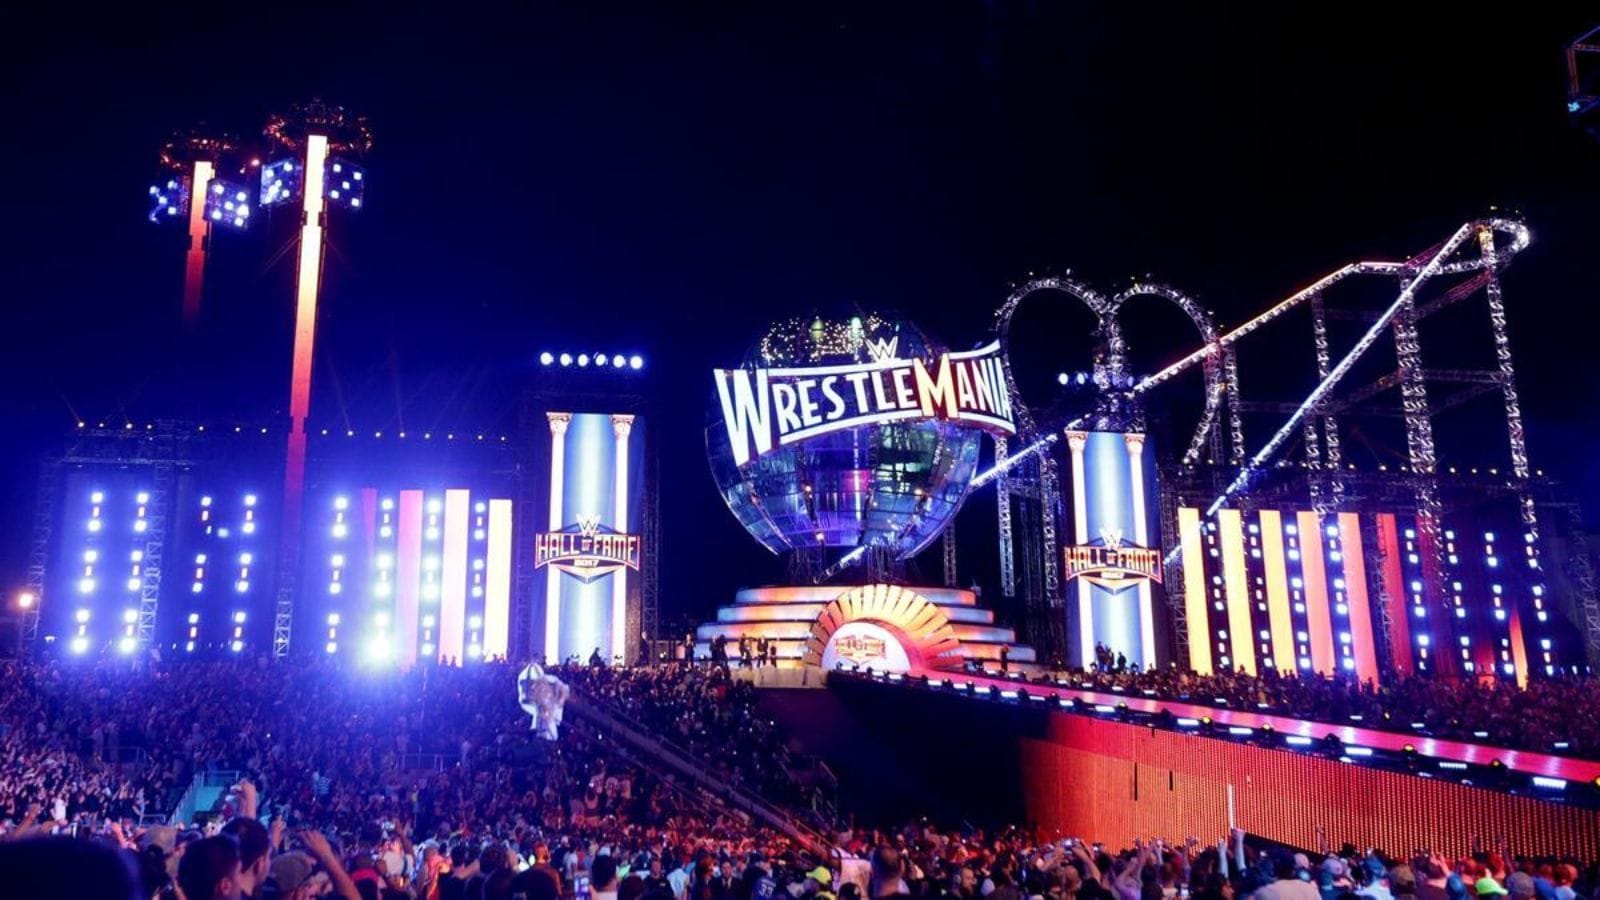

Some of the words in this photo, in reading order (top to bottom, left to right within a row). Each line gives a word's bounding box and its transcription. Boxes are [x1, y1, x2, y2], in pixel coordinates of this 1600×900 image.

[713, 353, 1013, 466] WRESTLEMANIA
[538, 534, 579, 560] HALL
[593, 535, 636, 561] FAME
[1068, 547, 1106, 572] HALL
[1117, 549, 1156, 573] FAME
